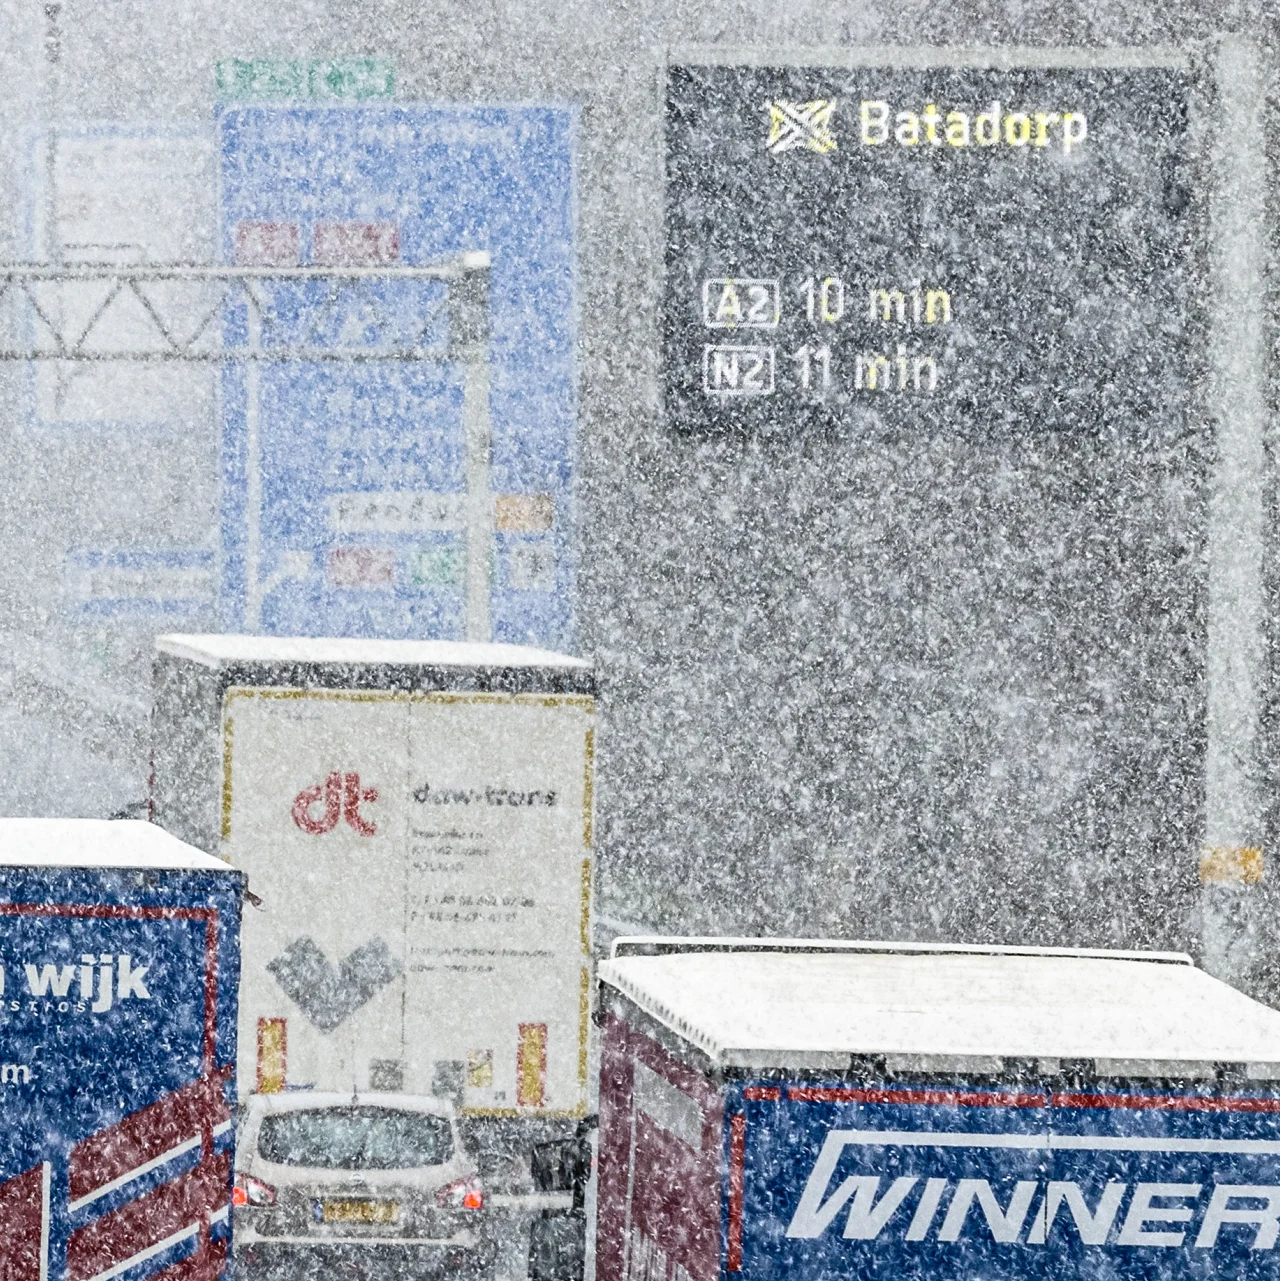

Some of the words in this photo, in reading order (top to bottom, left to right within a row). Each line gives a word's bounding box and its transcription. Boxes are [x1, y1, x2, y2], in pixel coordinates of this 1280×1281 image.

[860, 100, 1089, 155] Batadorp
[714, 286, 773, 324] A2
[801, 278, 845, 322] 10
[868, 280, 952, 324] min
[712, 351, 766, 389] N2
[794, 344, 832, 390] 11
[854, 345, 938, 392] min
[26, 953, 151, 1014] wijk
